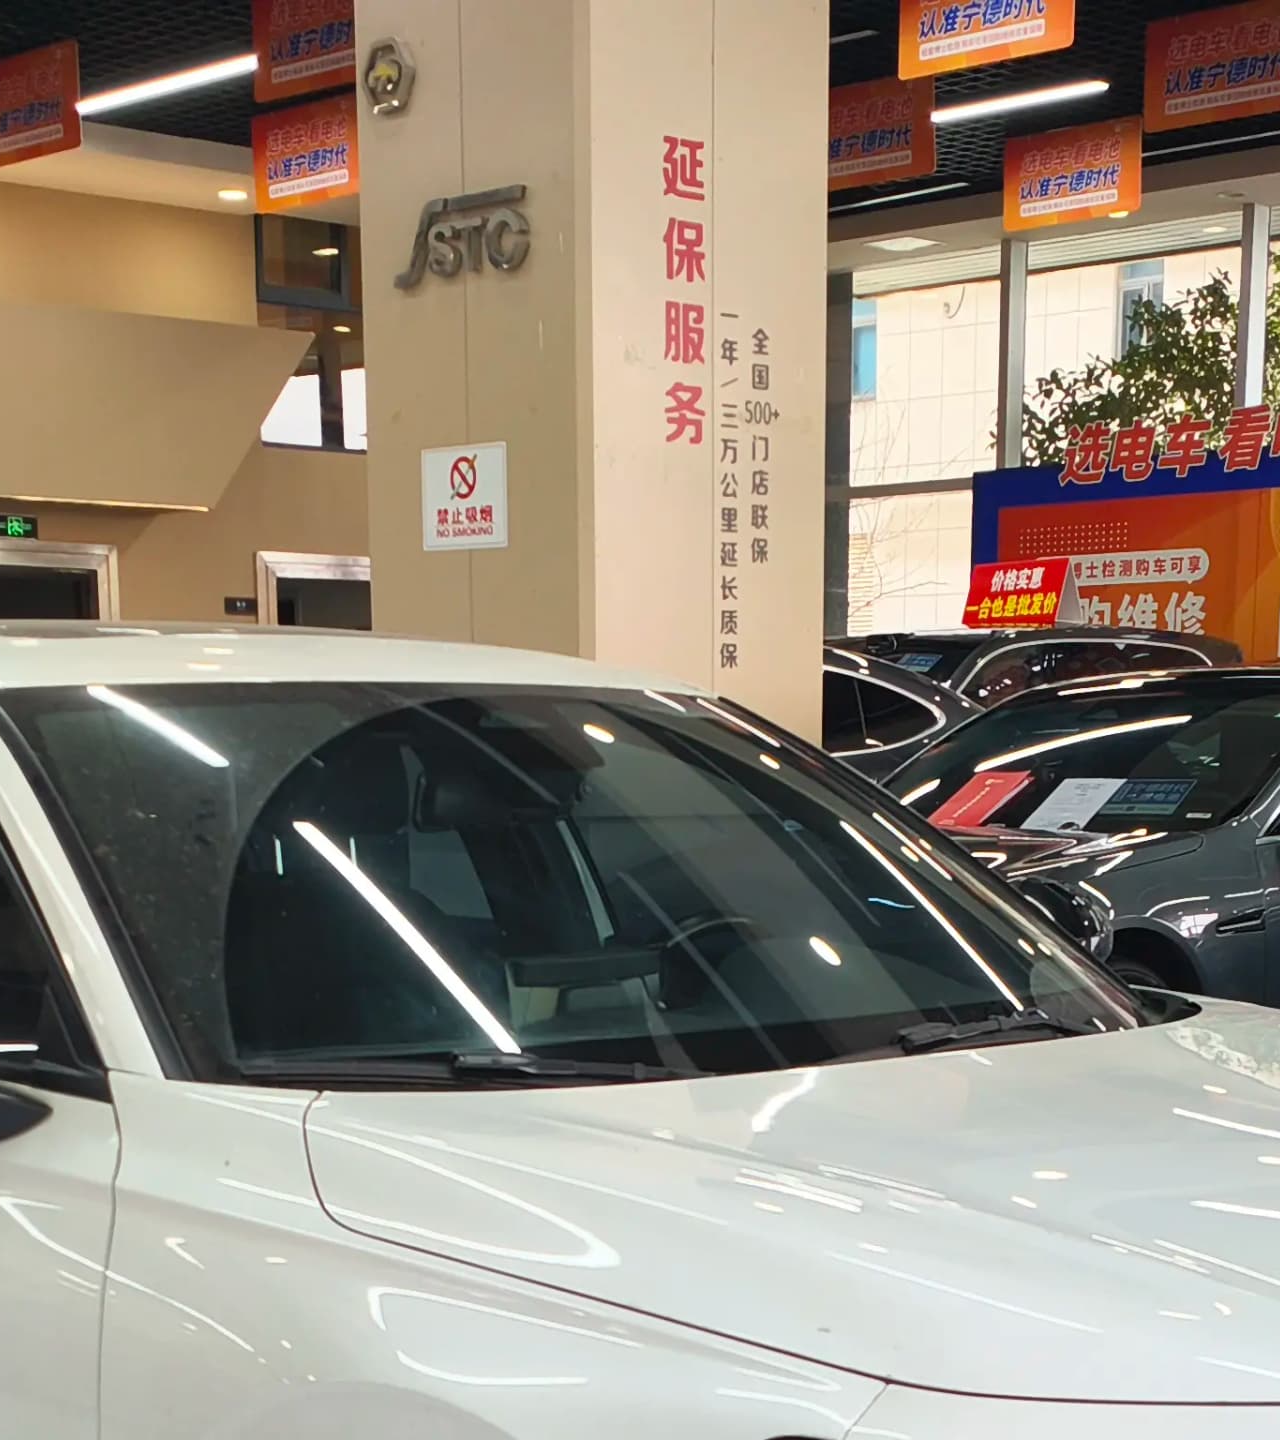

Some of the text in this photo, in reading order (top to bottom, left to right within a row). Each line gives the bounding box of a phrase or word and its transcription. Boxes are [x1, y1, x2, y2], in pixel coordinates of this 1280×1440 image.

[267, 143, 349, 181] 认准宁德时代
[1023, 137, 1120, 174] 选电车看电池
[1020, 163, 1120, 200] 认准宁德时代
[662, 135, 706, 445] 延保服务
[744, 327, 780, 565] 全国500+门店联保
[720, 311, 739, 669] 一年/三万公里延长质保
[436, 525, 494, 538] NO SMOKING
[437, 505, 493, 526] 禁止吸烟
[990, 566, 1046, 593] 价格实惠
[966, 591, 1057, 620] 一台也是批发价
